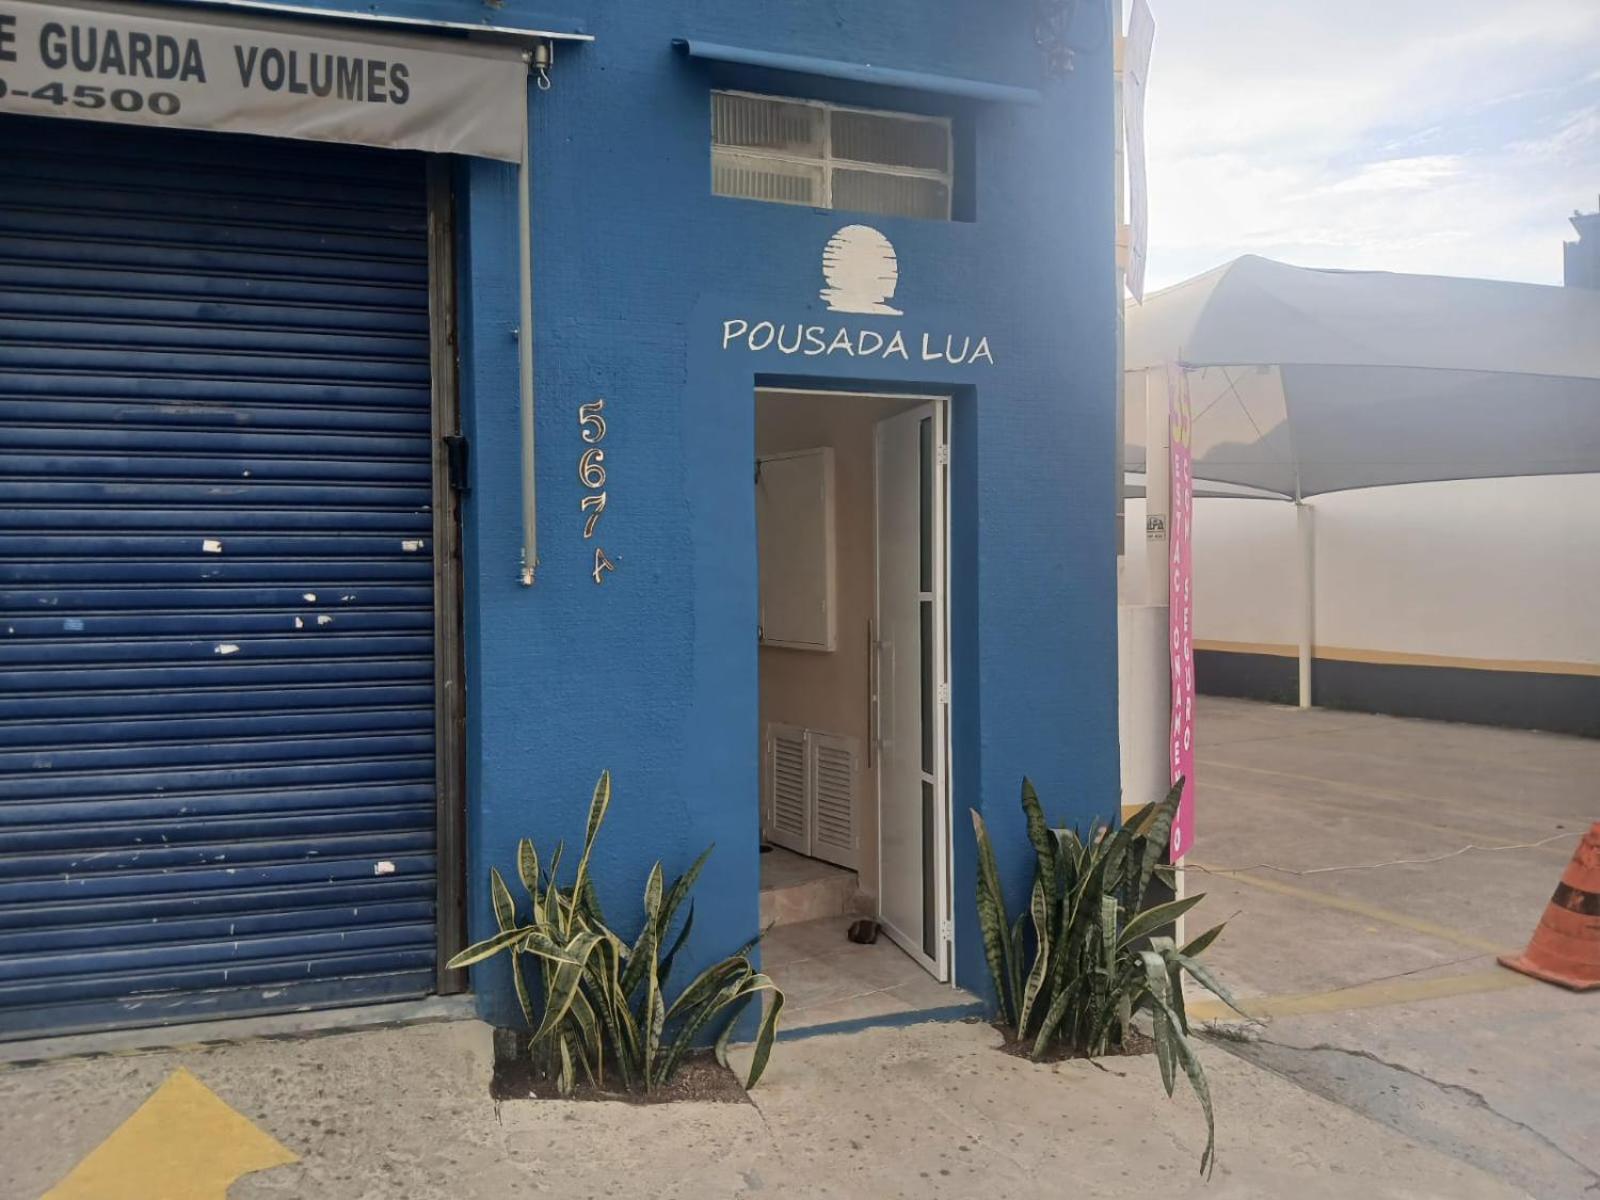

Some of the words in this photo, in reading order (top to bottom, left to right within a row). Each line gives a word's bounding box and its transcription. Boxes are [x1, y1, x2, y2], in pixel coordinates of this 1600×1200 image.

[40, 21, 206, 83] GUARDA
[234, 44, 410, 105] VOLUMES
[0, 77, 181, 116] -4500
[722, 318, 909, 361] POUSADA
[921, 332, 994, 366] LUA
[578, 399, 607, 538] 567
[592, 547, 616, 584] A
[1183, 576, 1192, 751] SEGURO
